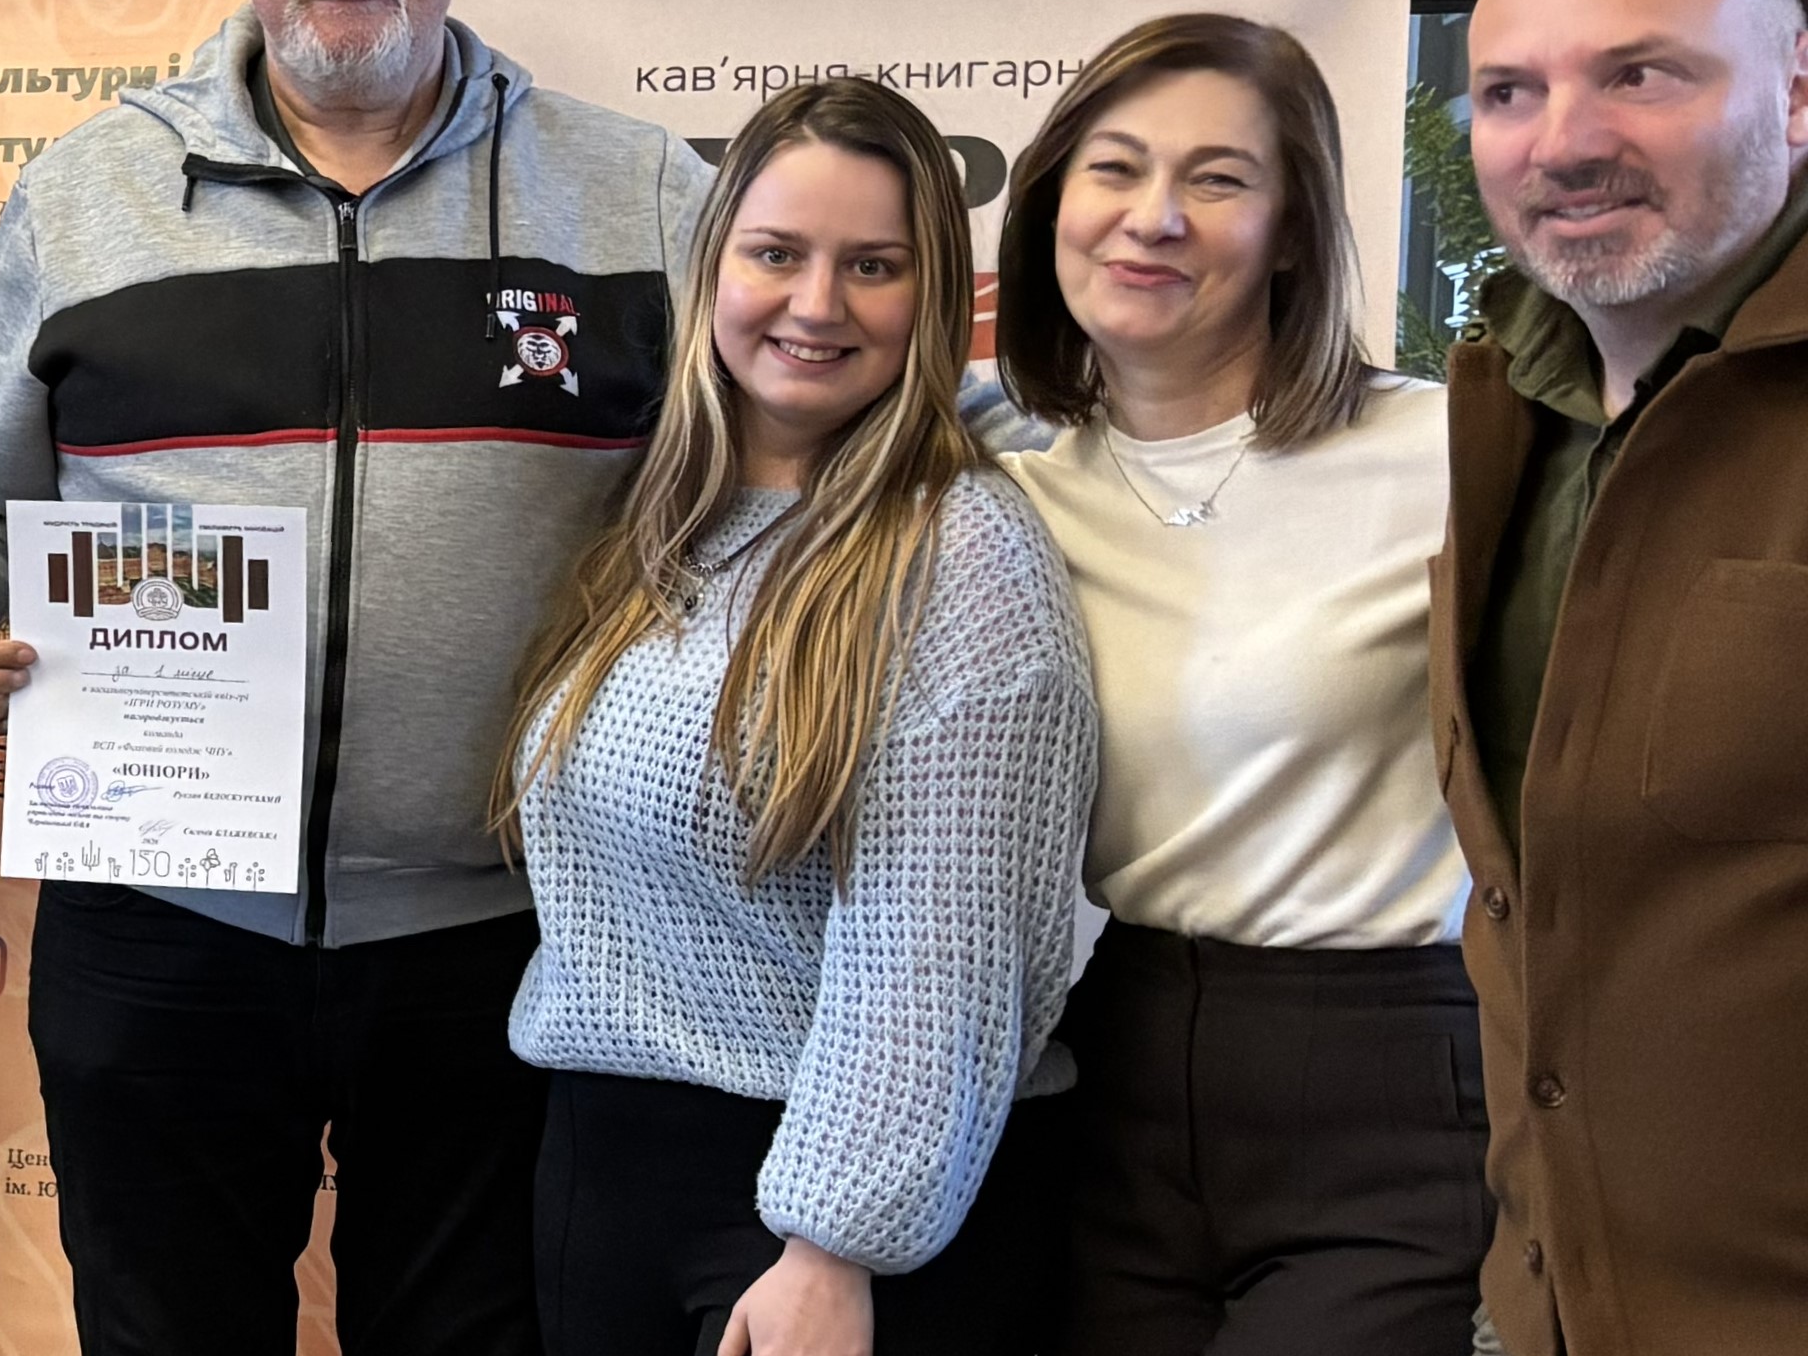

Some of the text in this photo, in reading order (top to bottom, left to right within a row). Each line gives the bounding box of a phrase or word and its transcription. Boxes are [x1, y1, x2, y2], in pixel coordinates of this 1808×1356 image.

[89, 627, 228, 652] ДИПЛОМ
[154, 664, 165, 678] 1
[112, 763, 211, 780] «ЮНІОРИ»
[129, 849, 171, 878] 150
[5, 1177, 31, 1196] ім.
